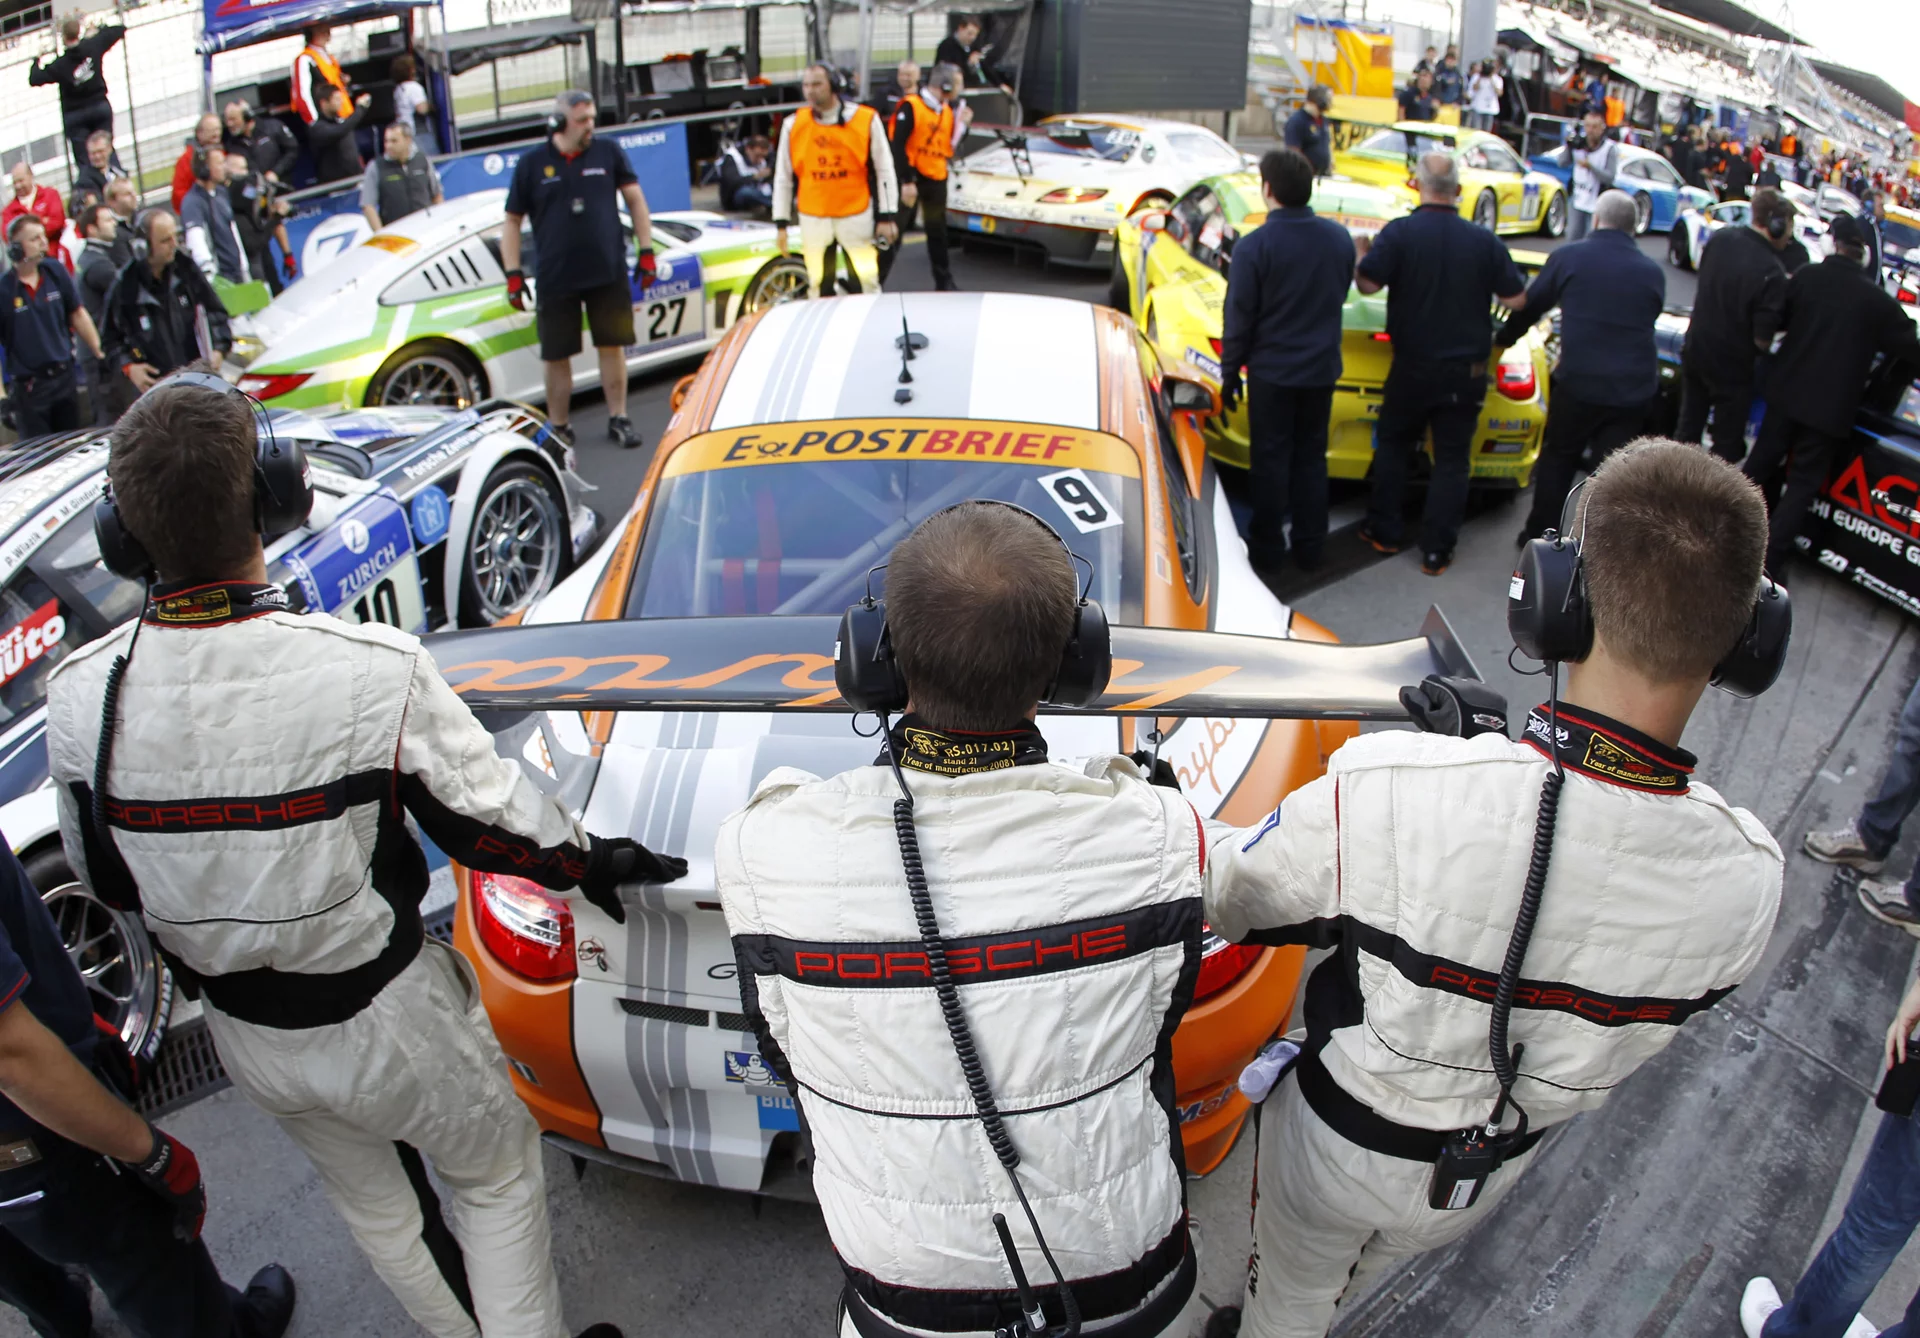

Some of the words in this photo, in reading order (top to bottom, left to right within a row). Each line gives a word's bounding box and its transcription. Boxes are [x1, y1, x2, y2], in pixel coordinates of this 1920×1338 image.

[812, 170, 848, 181] TEAM
[648, 297, 687, 341] 27
[402, 448, 448, 480] Porsche
[1053, 475, 1108, 527] 9
[1833, 509, 1904, 555] EUROPE
[337, 542, 397, 600] ZURICH
[354, 577, 401, 627] 10
[906, 755, 923, 768] Year
[924, 762, 933, 771] of
[943, 757, 966, 765] stand
[1589, 757, 1605, 771] Year
[1607, 765, 1615, 773] of
[1616, 768, 1660, 783] manufacture
[106, 792, 328, 828] PORSCHE
[795, 924, 1126, 979] PORSCHE
[1429, 965, 1677, 1022] PORSCHE
[761, 1095, 797, 1110] BIL
